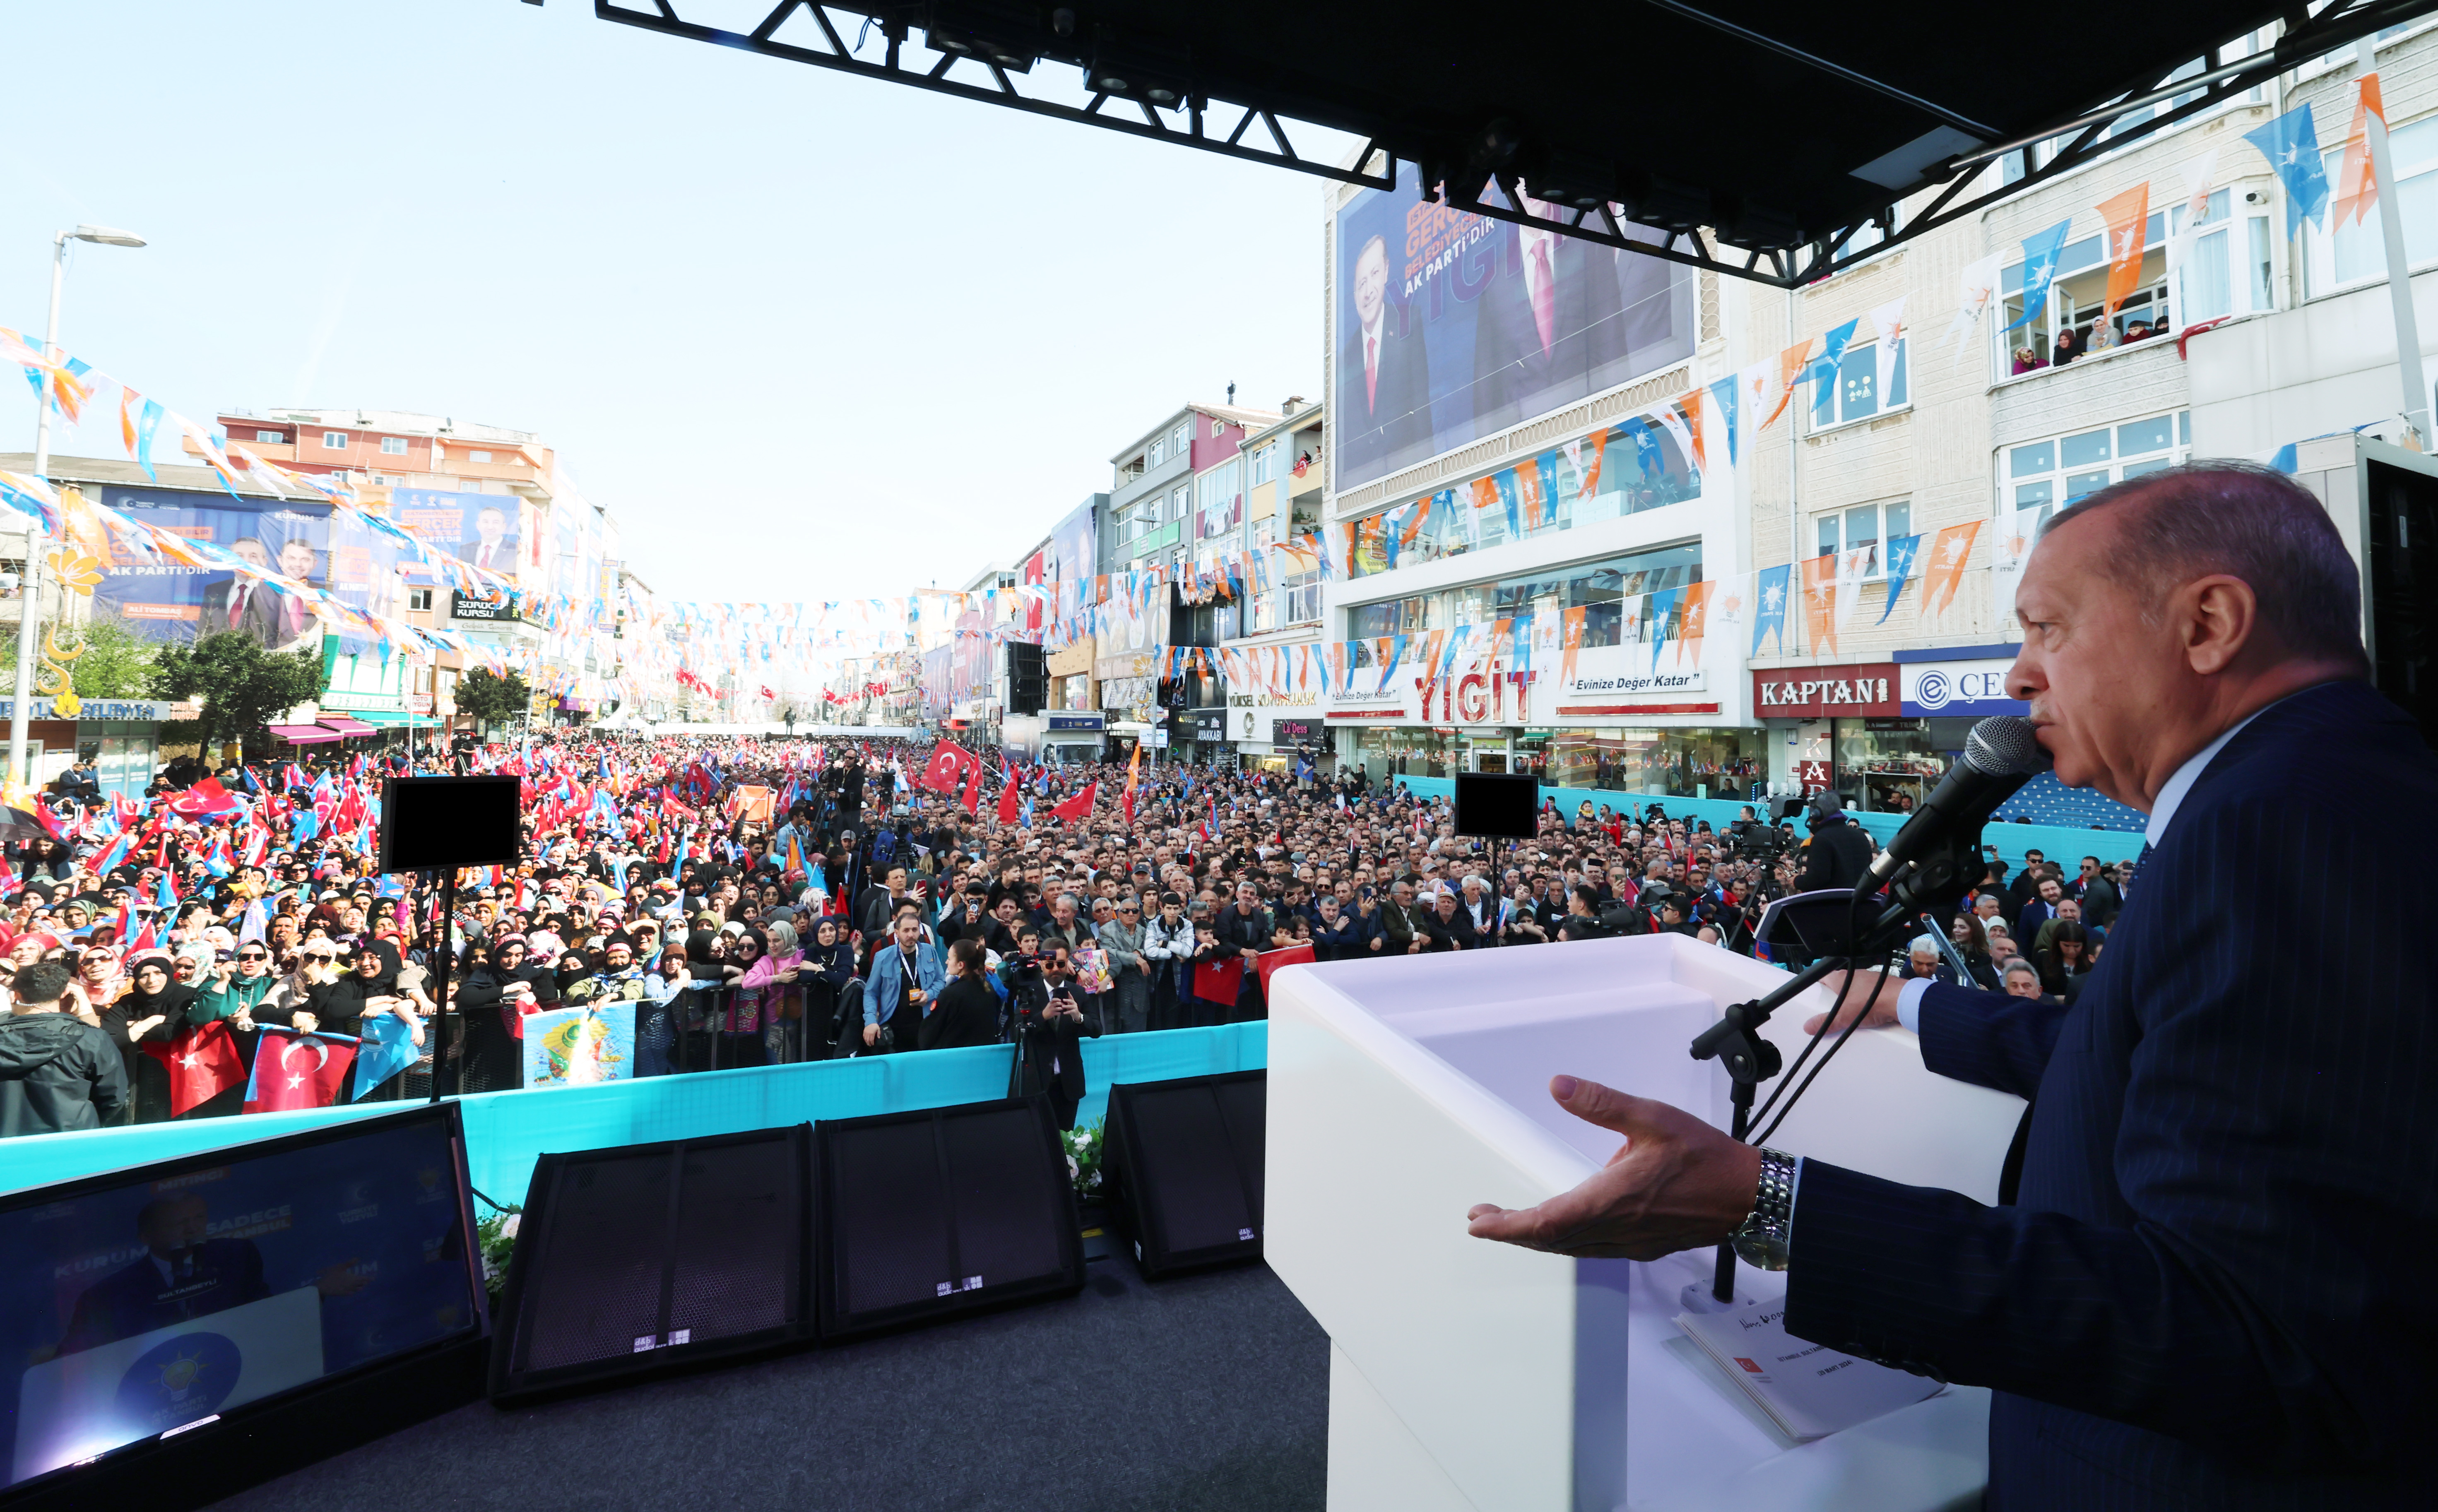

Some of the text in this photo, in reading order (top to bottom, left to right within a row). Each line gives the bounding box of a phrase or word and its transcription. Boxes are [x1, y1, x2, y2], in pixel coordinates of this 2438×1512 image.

[1405, 216, 1495, 298] AK PARTİ'DİR
[274, 512, 314, 522] KURUM
[108, 566, 210, 576] AK PARTİ'DİR
[458, 600, 503, 610] SÜRÜC
[457, 609, 494, 618] KURSU
[1576, 679, 1614, 690] Evinize
[1617, 677, 1652, 690] Değer
[1654, 675, 1690, 687] Katar
[1356, 691, 1373, 701] Değer
[1761, 678, 1875, 705] KAPTAN
[1229, 692, 1255, 707] YÜKSEL
[1197, 730, 1223, 742] AYAKKABI
[206, 1204, 291, 1235] SADECE
[54, 1245, 149, 1279] KURUM
[635, 1337, 651, 1346] d&b
[1824, 1365, 1839, 1374] MART
[178, 1420, 203, 1432] onvo
